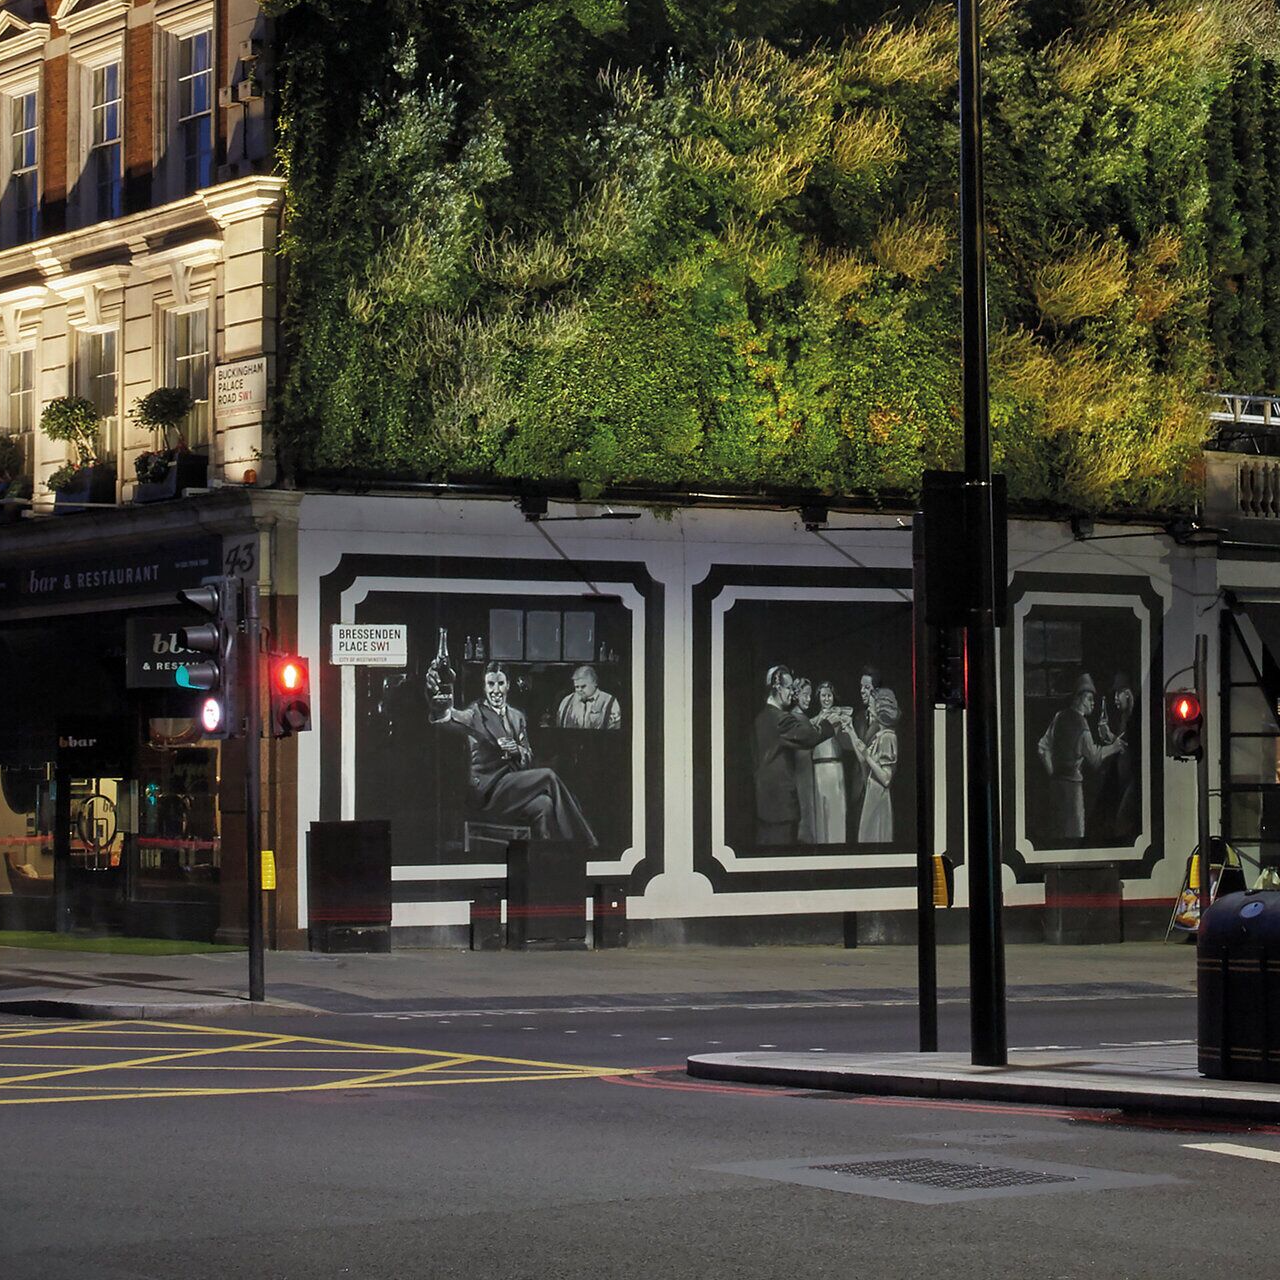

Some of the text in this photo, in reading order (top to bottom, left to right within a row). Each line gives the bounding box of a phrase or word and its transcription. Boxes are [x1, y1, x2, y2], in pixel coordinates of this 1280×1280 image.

[218, 363, 263, 381] BUCKINGHAM
[218, 379, 243, 393] PALACE
[218, 390, 252, 406] ROAD SW1
[225, 542, 255, 577] 43
[64, 577, 71, 590] &
[77, 564, 160, 589] RESTAURANT
[339, 629, 401, 639] BRESSENDEN
[339, 641, 390, 652] PLACE SW1
[142, 662, 151, 671] &
